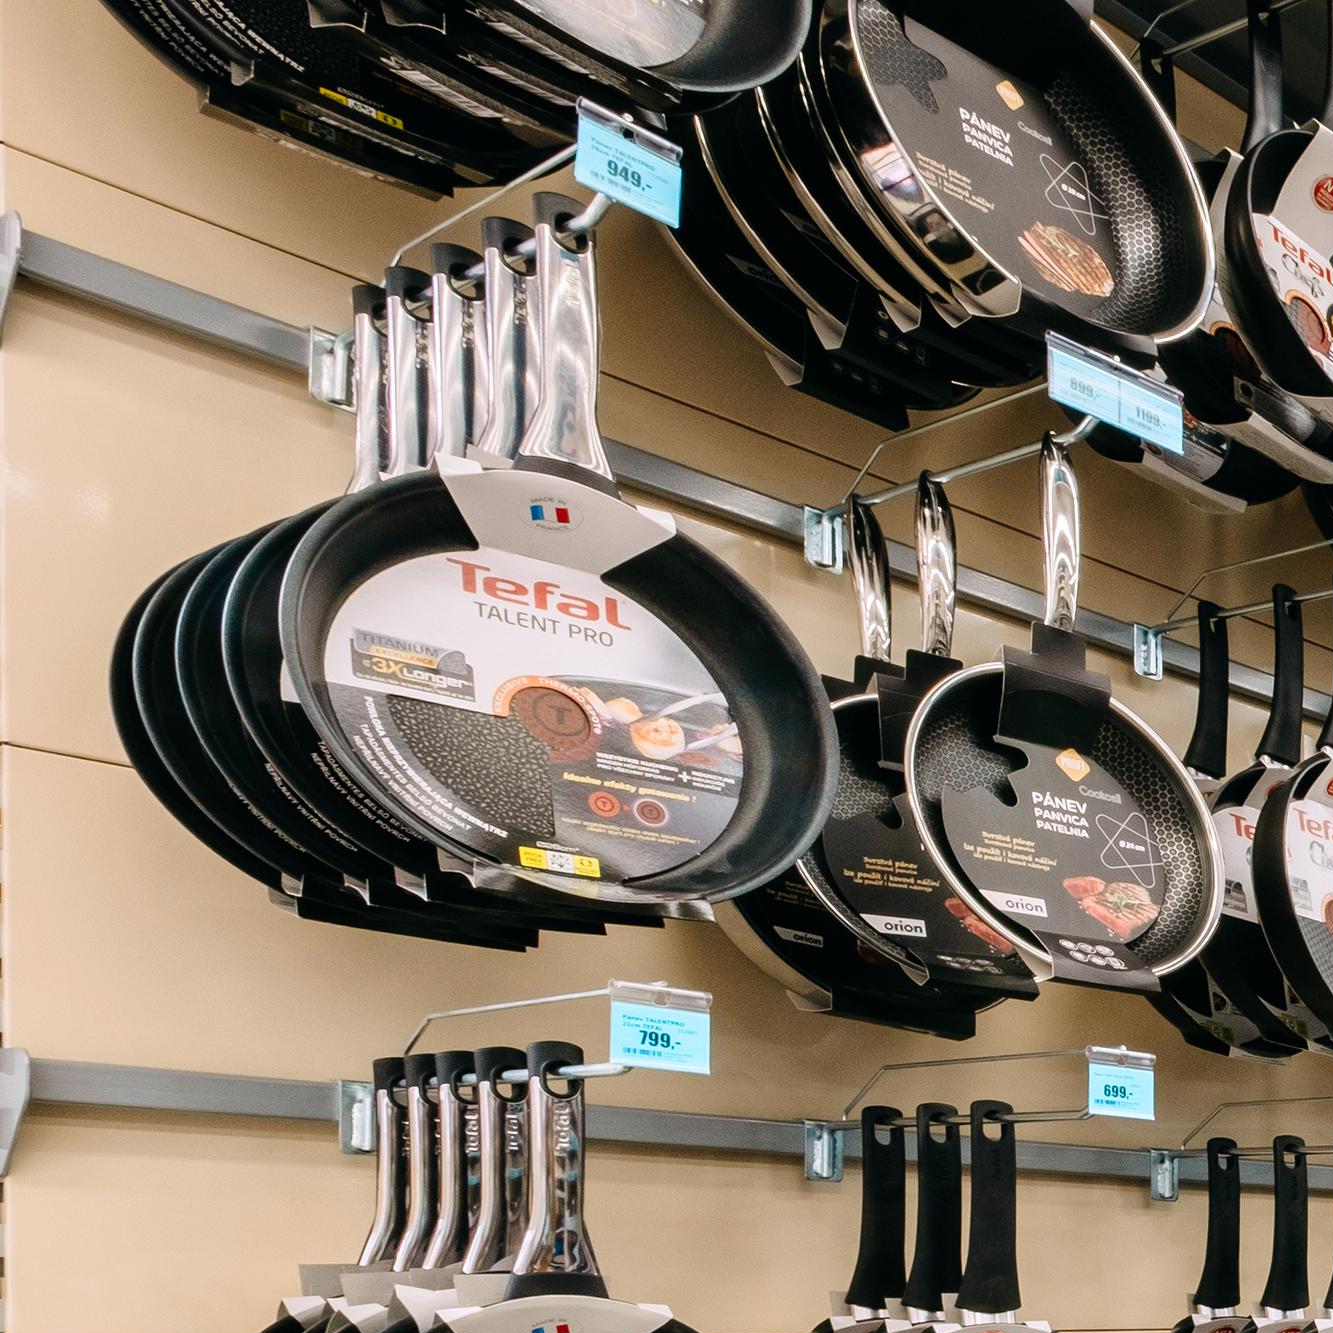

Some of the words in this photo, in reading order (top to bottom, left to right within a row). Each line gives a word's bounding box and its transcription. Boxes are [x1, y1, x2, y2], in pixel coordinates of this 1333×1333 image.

[446, 556, 632, 631] Tefal
[473, 601, 561, 635] TALENT
[568, 623, 614, 648] PRO
[361, 633, 440, 658] TITANIUM
[371, 656, 404, 677] 3X
[1031, 791, 1088, 815] PÁNEV
[1033, 807, 1090, 827] PANVICA
[1036, 820, 1090, 839] PATELNIA
[1005, 898, 1044, 913] orion
[884, 920, 923, 934] orion
[793, 931, 823, 946] orion
[639, 1029, 681, 1050] 799,-
[1103, 1084, 1133, 1100] 699,-
